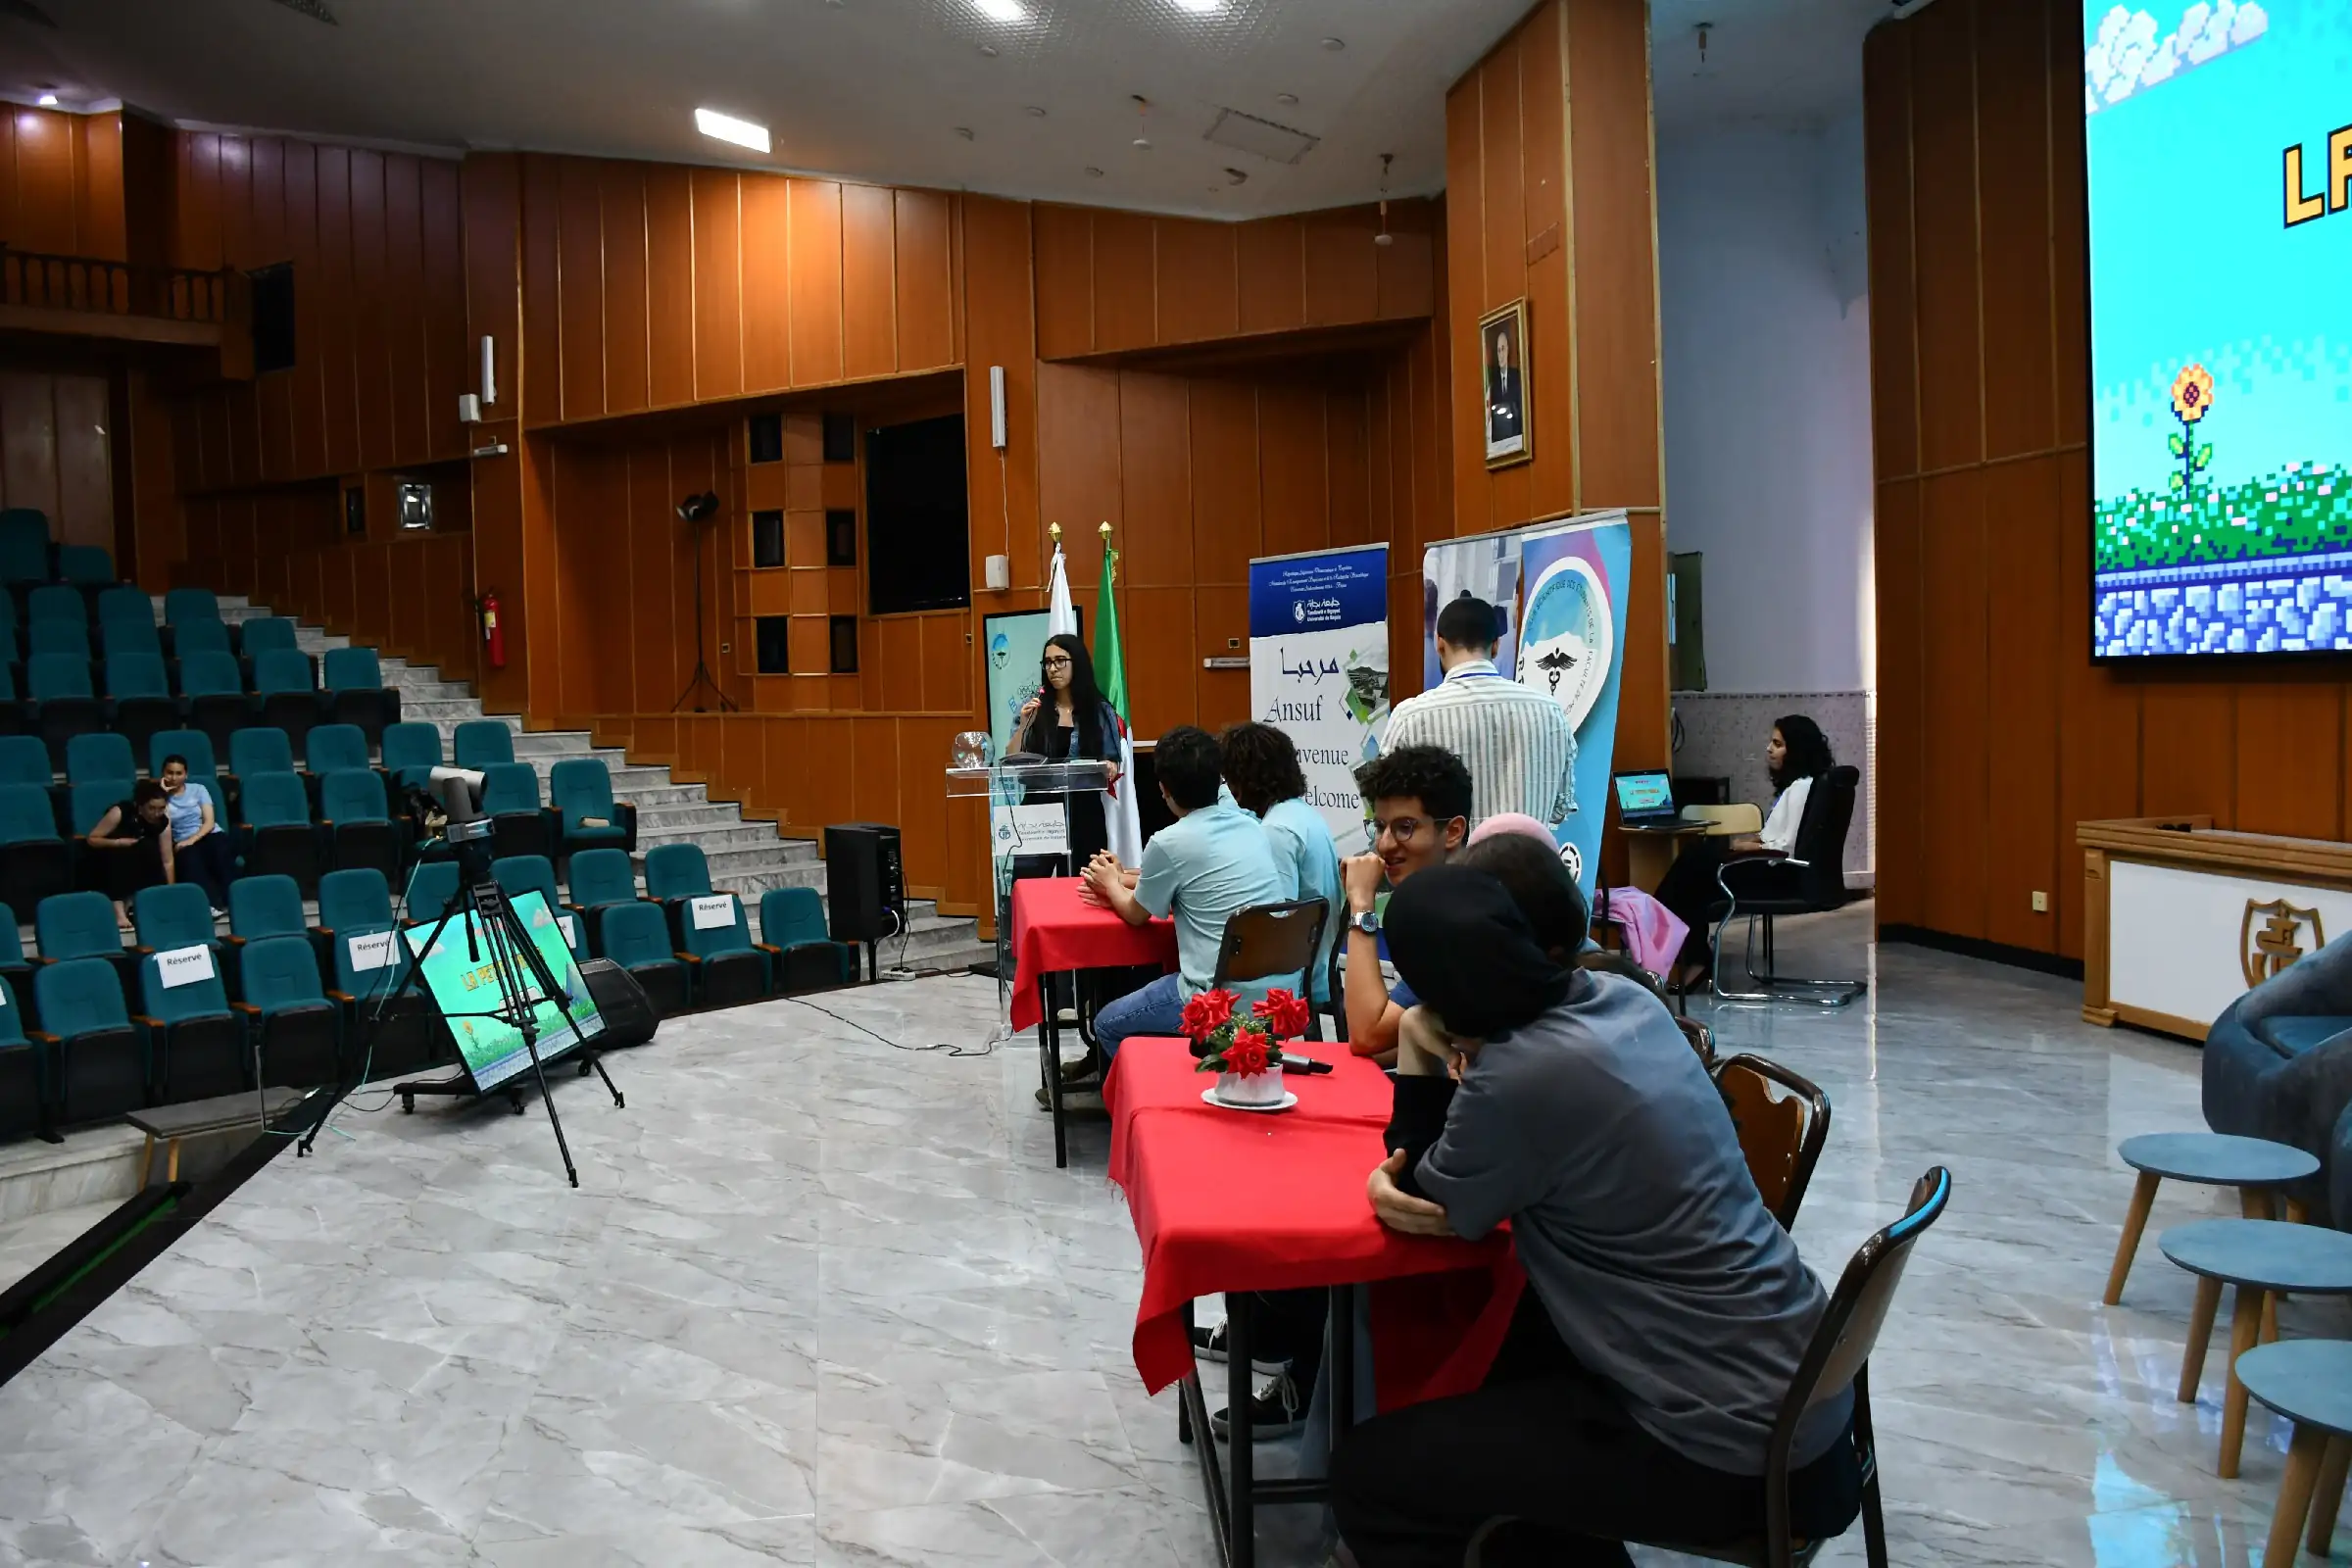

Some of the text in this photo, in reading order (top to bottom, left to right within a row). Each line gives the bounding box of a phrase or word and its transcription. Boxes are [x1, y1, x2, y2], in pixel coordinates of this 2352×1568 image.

[1280, 647, 1339, 685] مرحبا
[1263, 695, 1323, 723] Ansuf
[1304, 785, 1360, 809] elcome
[698, 902, 727, 911] Réservé
[167, 953, 202, 966] Réservé
[461, 970, 479, 992] LA
